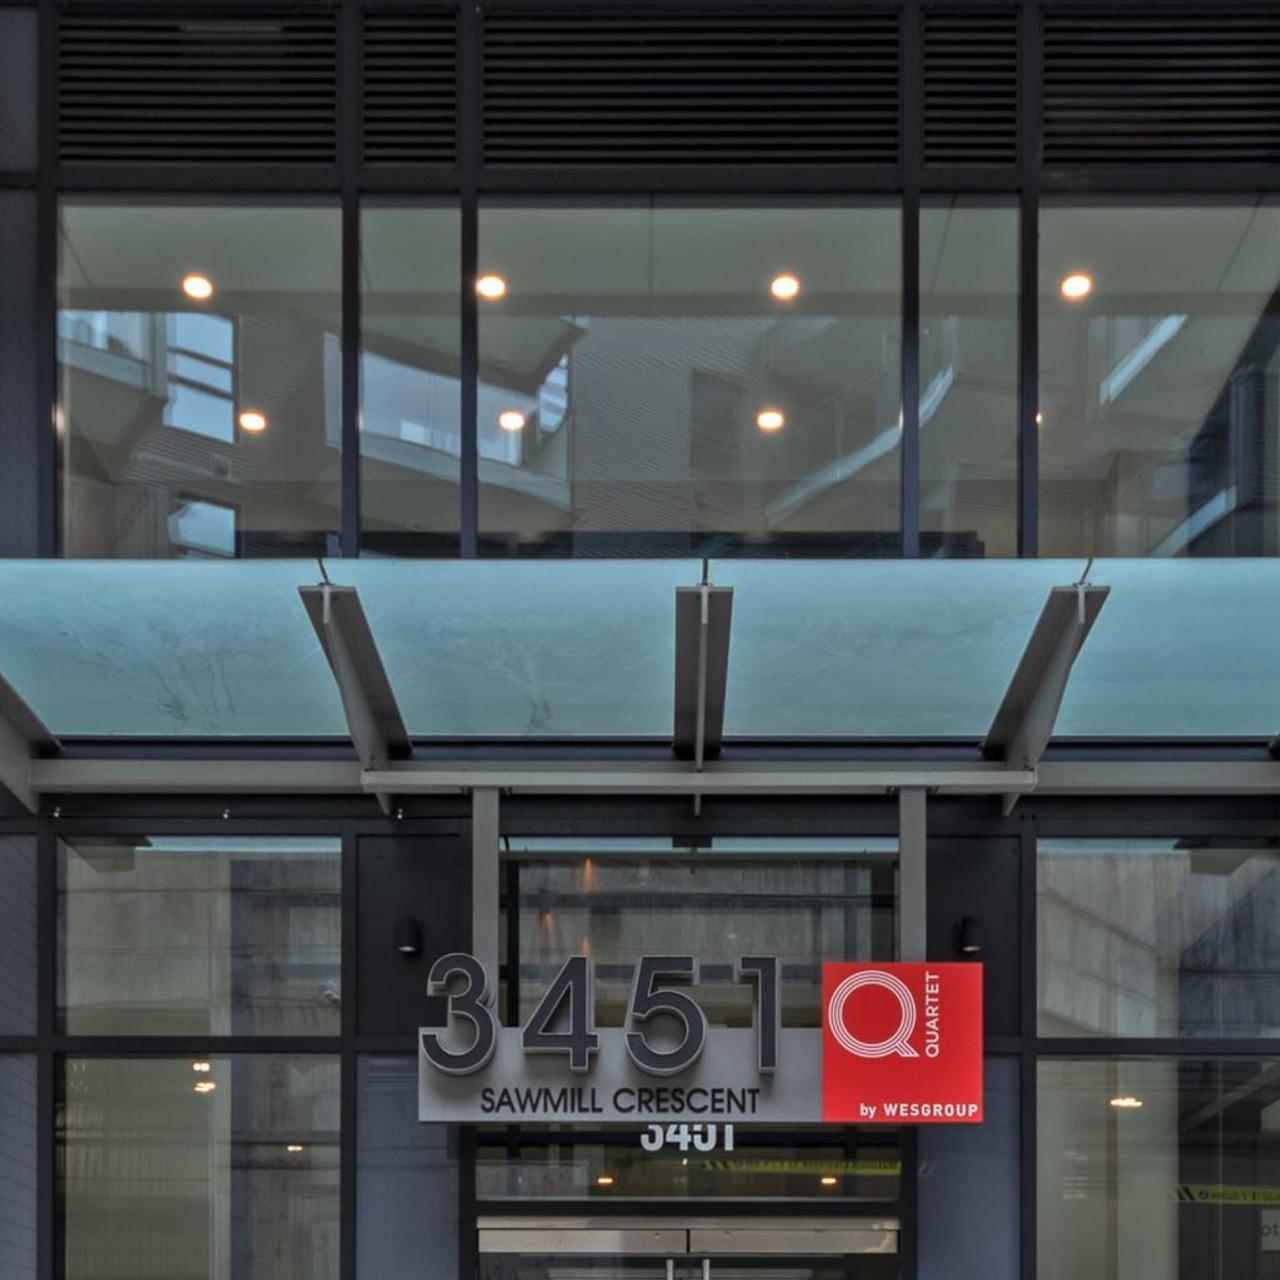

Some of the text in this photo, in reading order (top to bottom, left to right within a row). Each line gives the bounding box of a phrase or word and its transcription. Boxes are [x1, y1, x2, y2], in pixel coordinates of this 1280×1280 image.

[421, 953, 781, 1077] 3451
[828, 969, 919, 1058] Q
[924, 971, 941, 1059] QUARTET
[480, 1087, 761, 1115] SAWMILL CRESCENT
[859, 1102, 979, 1119] by WESGROUP
